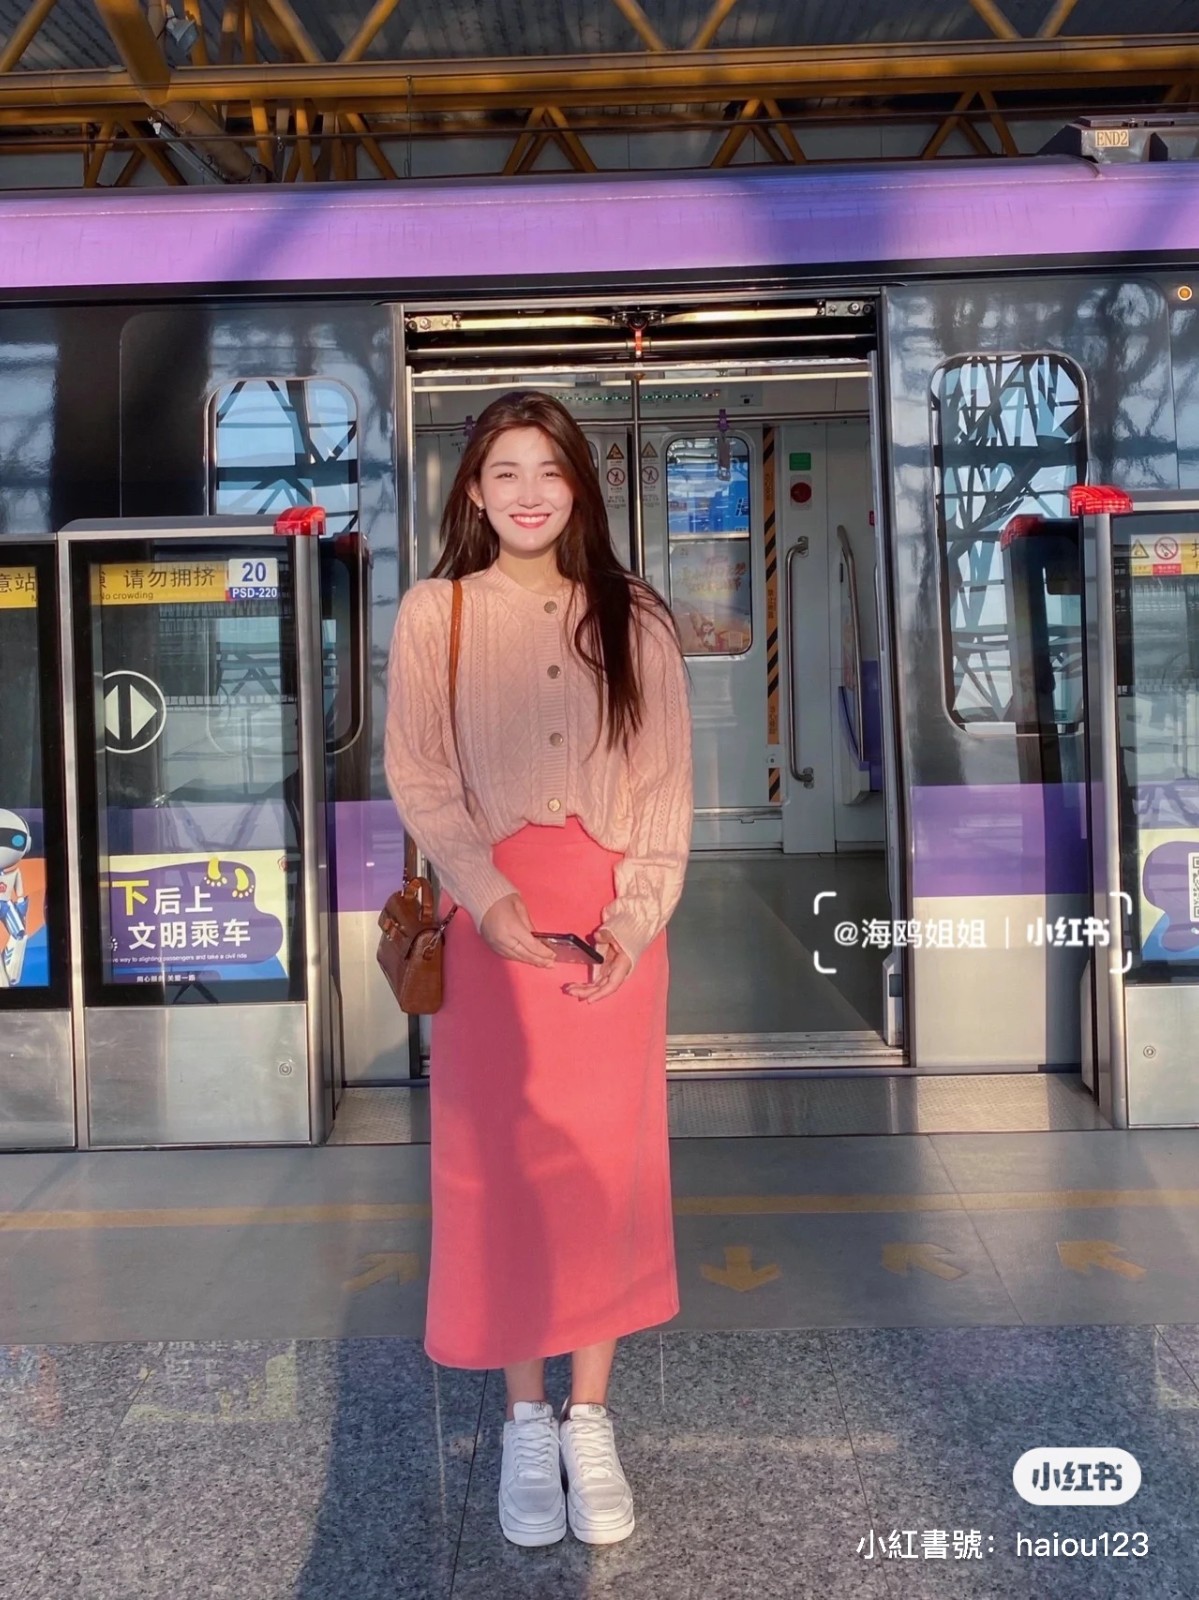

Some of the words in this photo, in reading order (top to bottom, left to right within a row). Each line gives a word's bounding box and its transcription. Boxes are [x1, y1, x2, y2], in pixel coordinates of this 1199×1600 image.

[1096, 131, 1128, 146] END2
[124, 566, 216, 590] 请勿拥挤
[242, 561, 266, 581] 20
[113, 592, 154, 601] crowding
[232, 587, 278, 599] PSD-220
[111, 880, 213, 916] 下后上
[128, 918, 251, 951] 文明乘车
